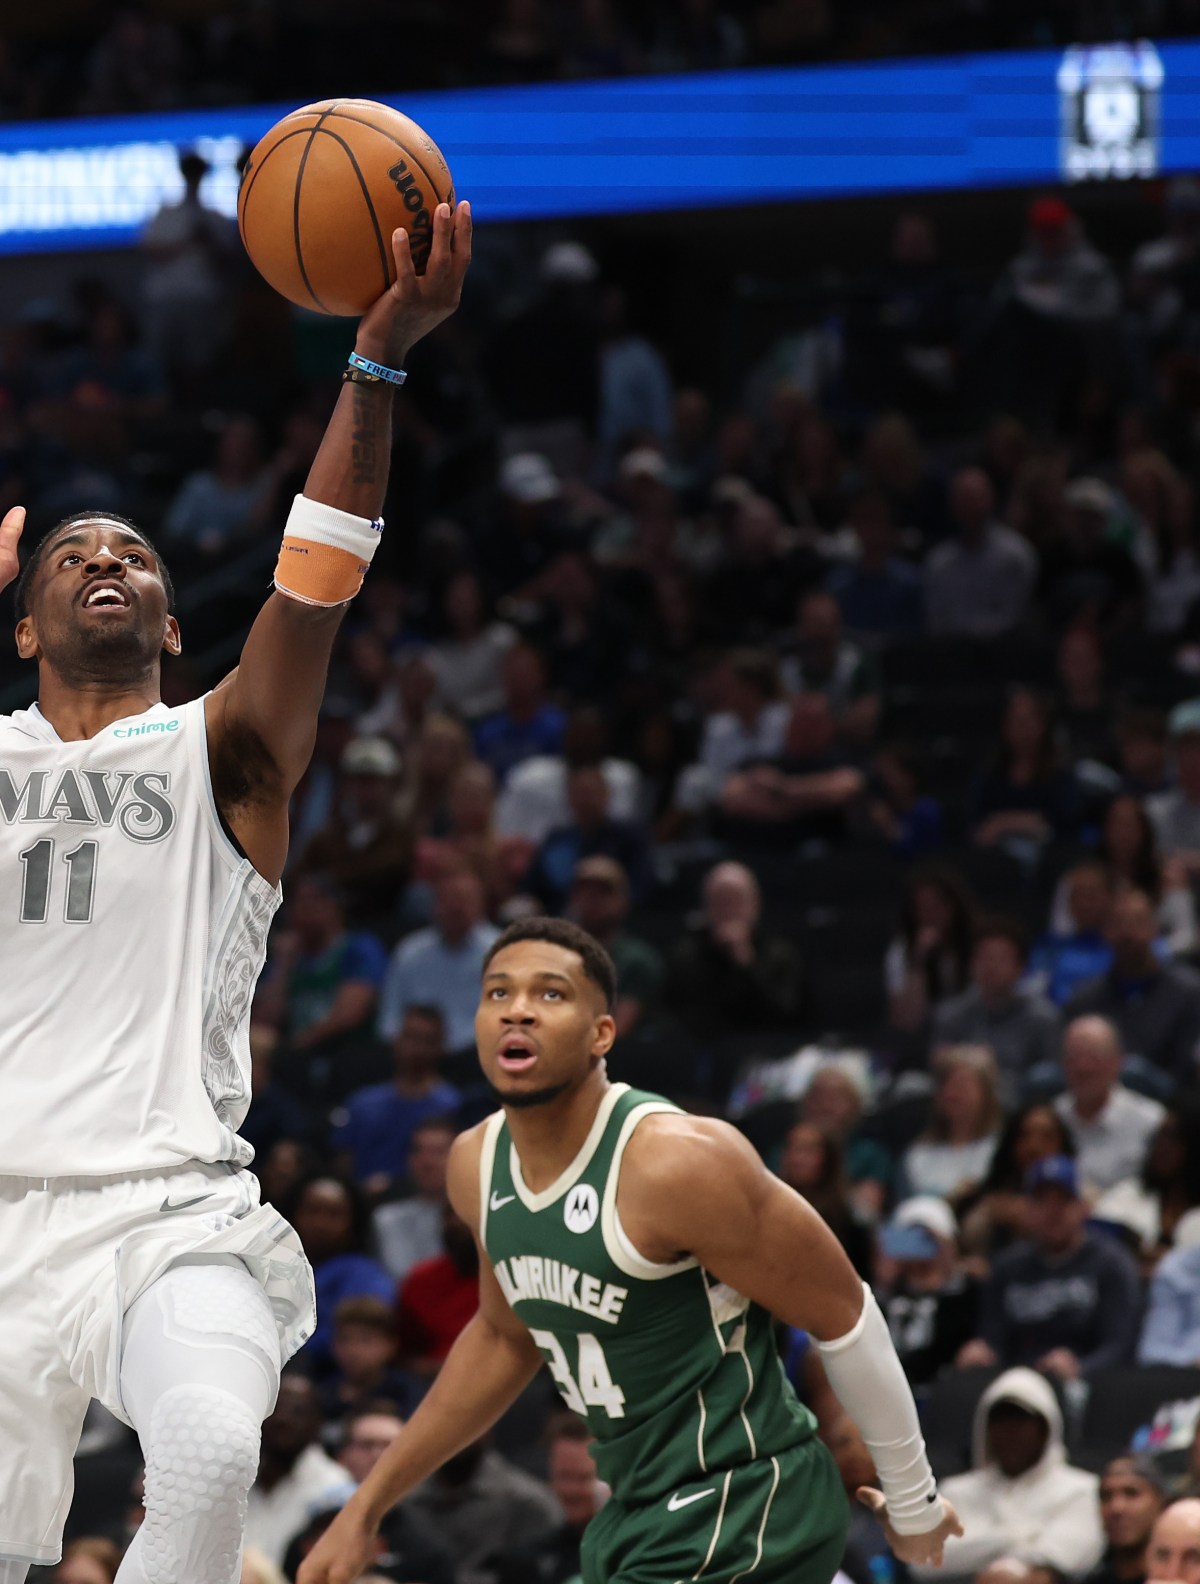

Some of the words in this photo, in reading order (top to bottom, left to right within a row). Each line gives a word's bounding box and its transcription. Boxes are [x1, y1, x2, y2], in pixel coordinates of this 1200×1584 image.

[366, 363, 392, 379] FREE
[113, 719, 179, 738] chime
[18, 838, 99, 924] 11
[528, 1327, 626, 1418] 34
